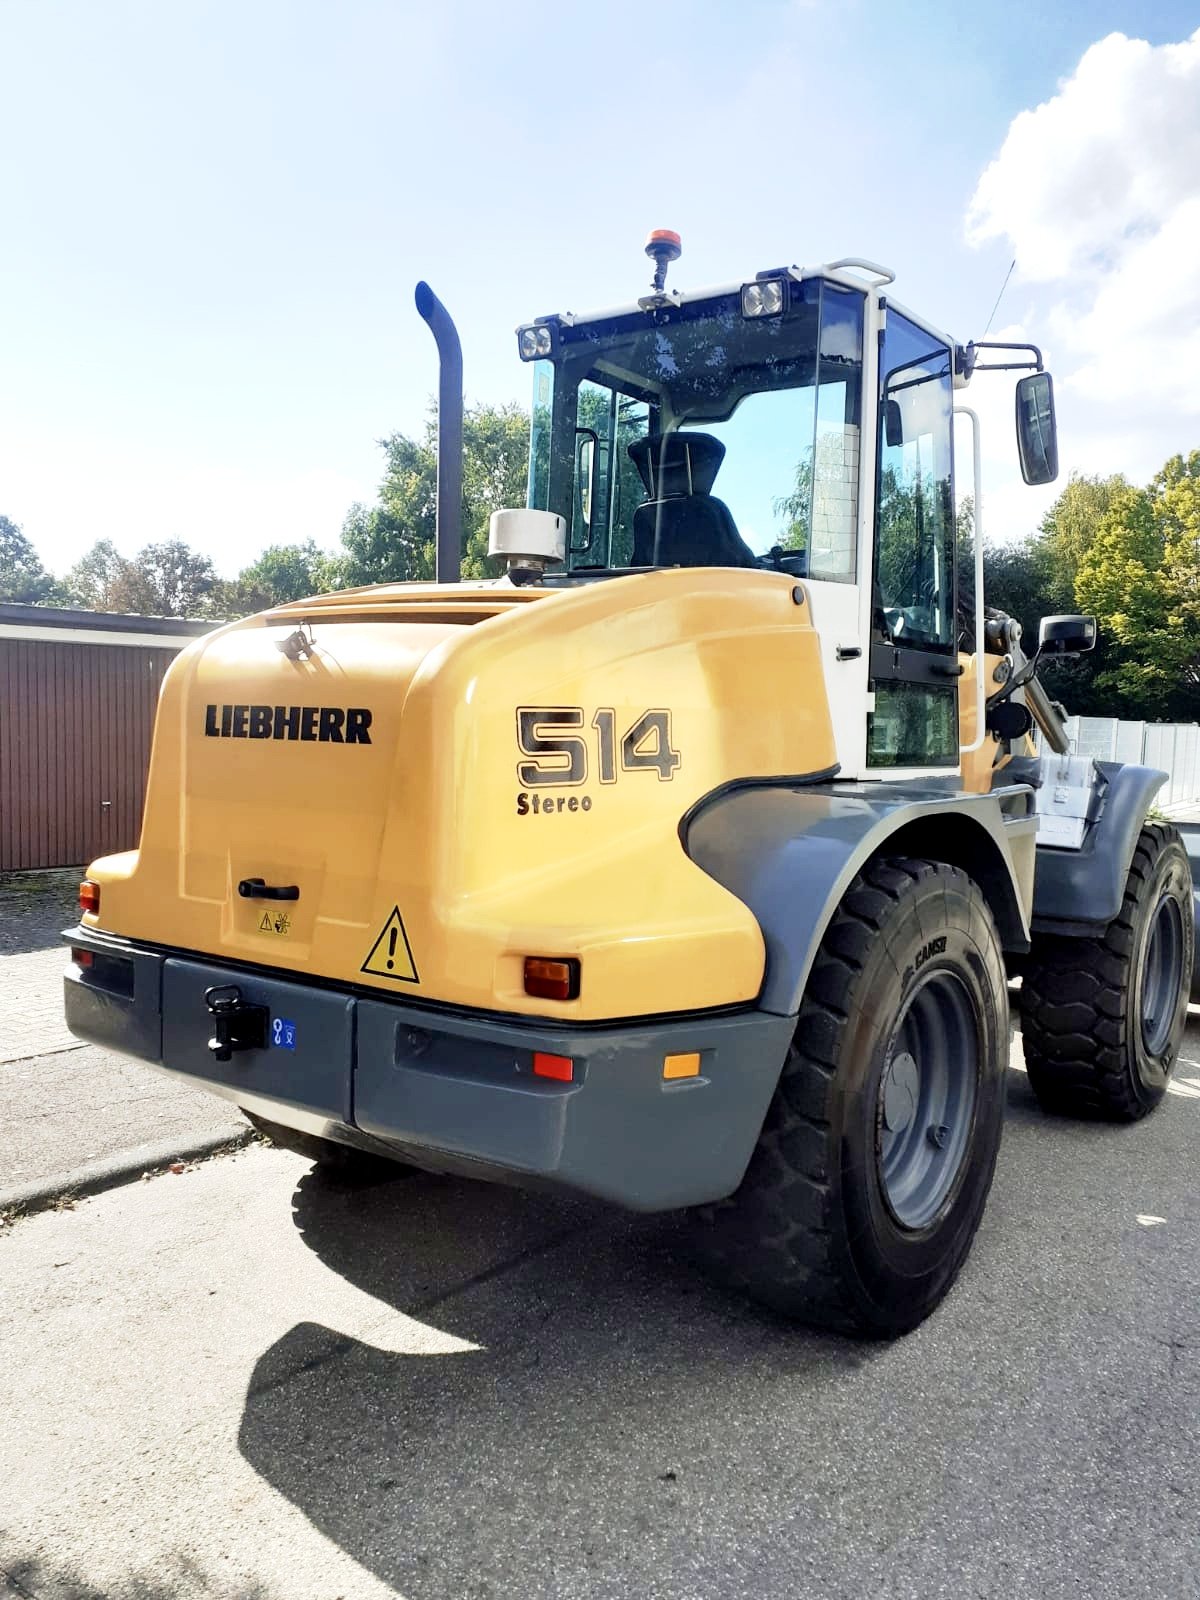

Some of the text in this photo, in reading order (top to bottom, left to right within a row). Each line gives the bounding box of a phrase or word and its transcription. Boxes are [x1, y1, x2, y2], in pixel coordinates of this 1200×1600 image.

[206, 705, 372, 744] LIEBHERR
[516, 706, 682, 788] 514
[517, 793, 592, 815] Stereo
